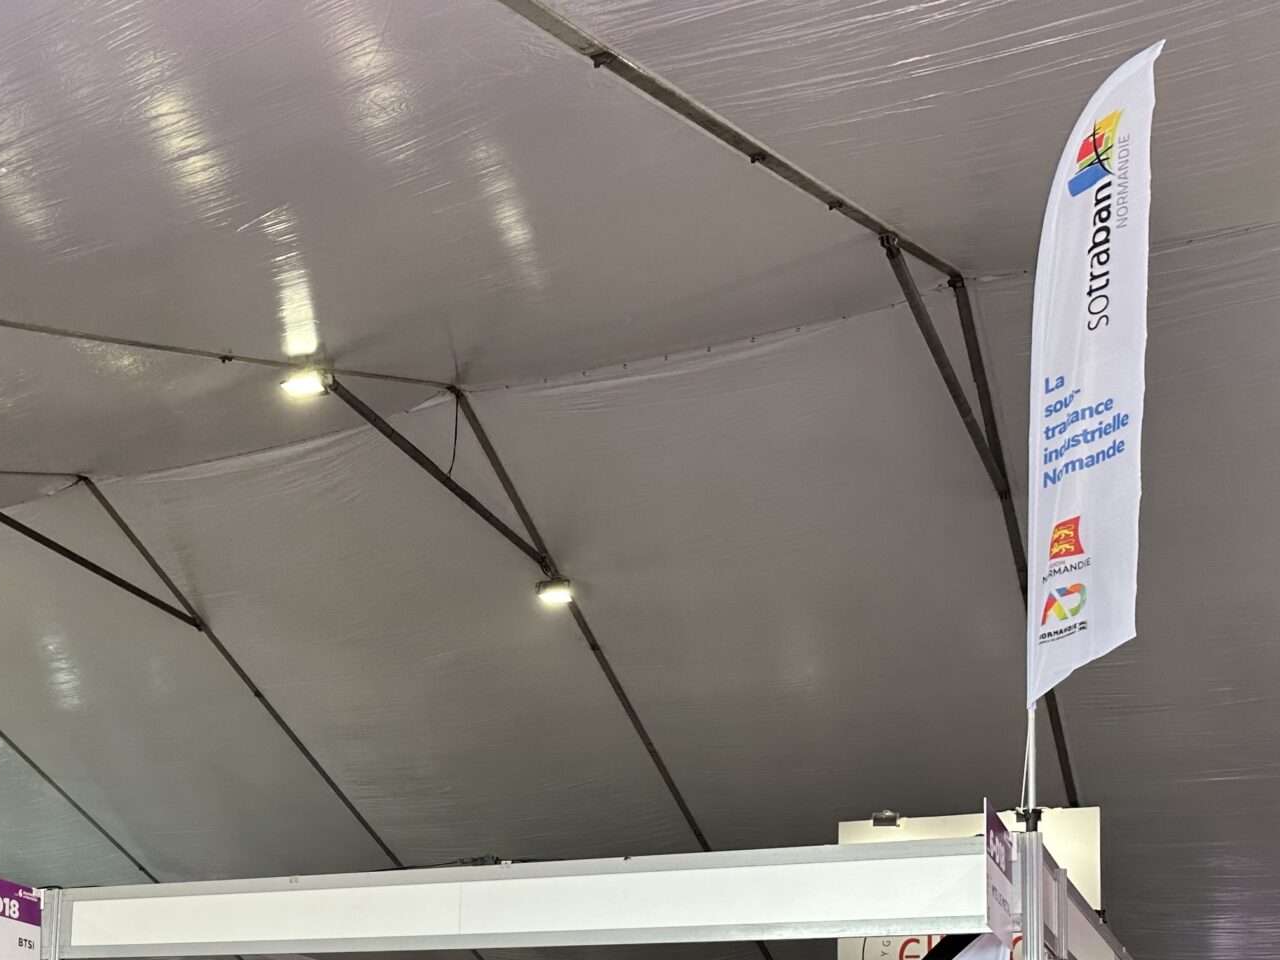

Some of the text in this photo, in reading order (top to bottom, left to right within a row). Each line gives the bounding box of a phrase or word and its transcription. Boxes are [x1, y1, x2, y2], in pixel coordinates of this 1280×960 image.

[1116, 133, 1130, 229] NORMANDIE
[1087, 180, 1113, 332] sotraban
[1044, 375, 1065, 395] La
[1044, 398, 1113, 441] traance
[1042, 438, 1125, 488] Nomande
[1042, 558, 1091, 584] NRMANDIE
[1039, 623, 1077, 640] ORMANDIE
[18, 937, 35, 950] BTSI
